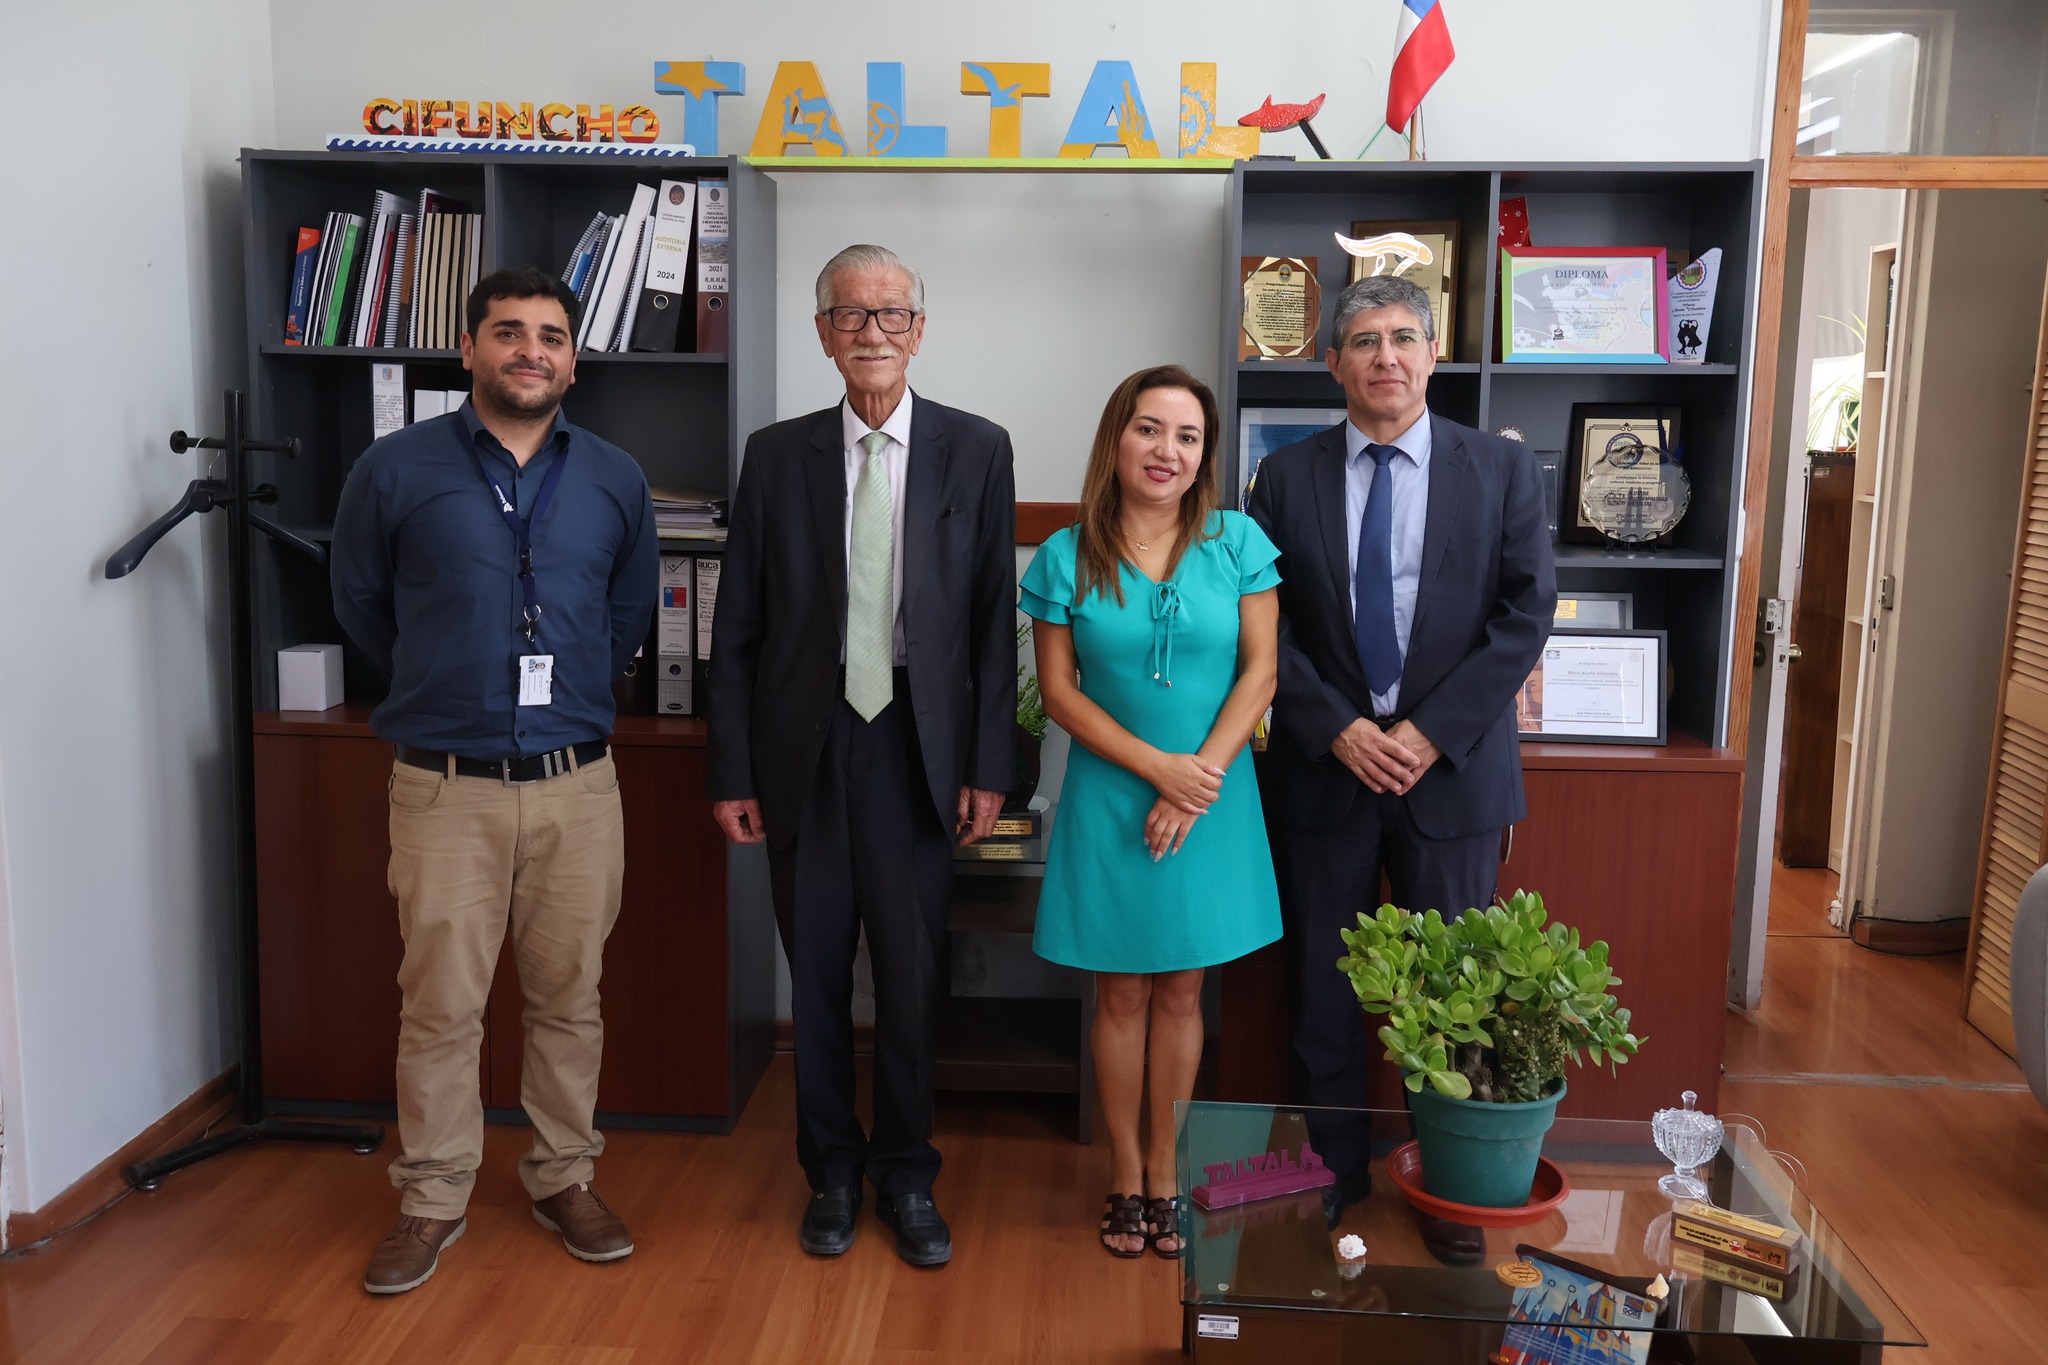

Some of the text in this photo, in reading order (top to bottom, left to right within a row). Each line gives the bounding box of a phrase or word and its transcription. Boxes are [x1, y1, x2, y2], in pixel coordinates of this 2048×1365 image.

[655, 60, 1260, 158] TALTAL
[362, 97, 661, 144] CIFUNCHO
[655, 235, 686, 246] AUDITORIA
[656, 243, 682, 253] EXTERNA
[657, 271, 675, 280] 2024
[1555, 269, 1609, 279] DIPLOMA
[697, 561, 719, 569] auca
[1204, 1150, 1296, 1186] TALTAL
[1622, 1307, 1642, 1319] GORE
